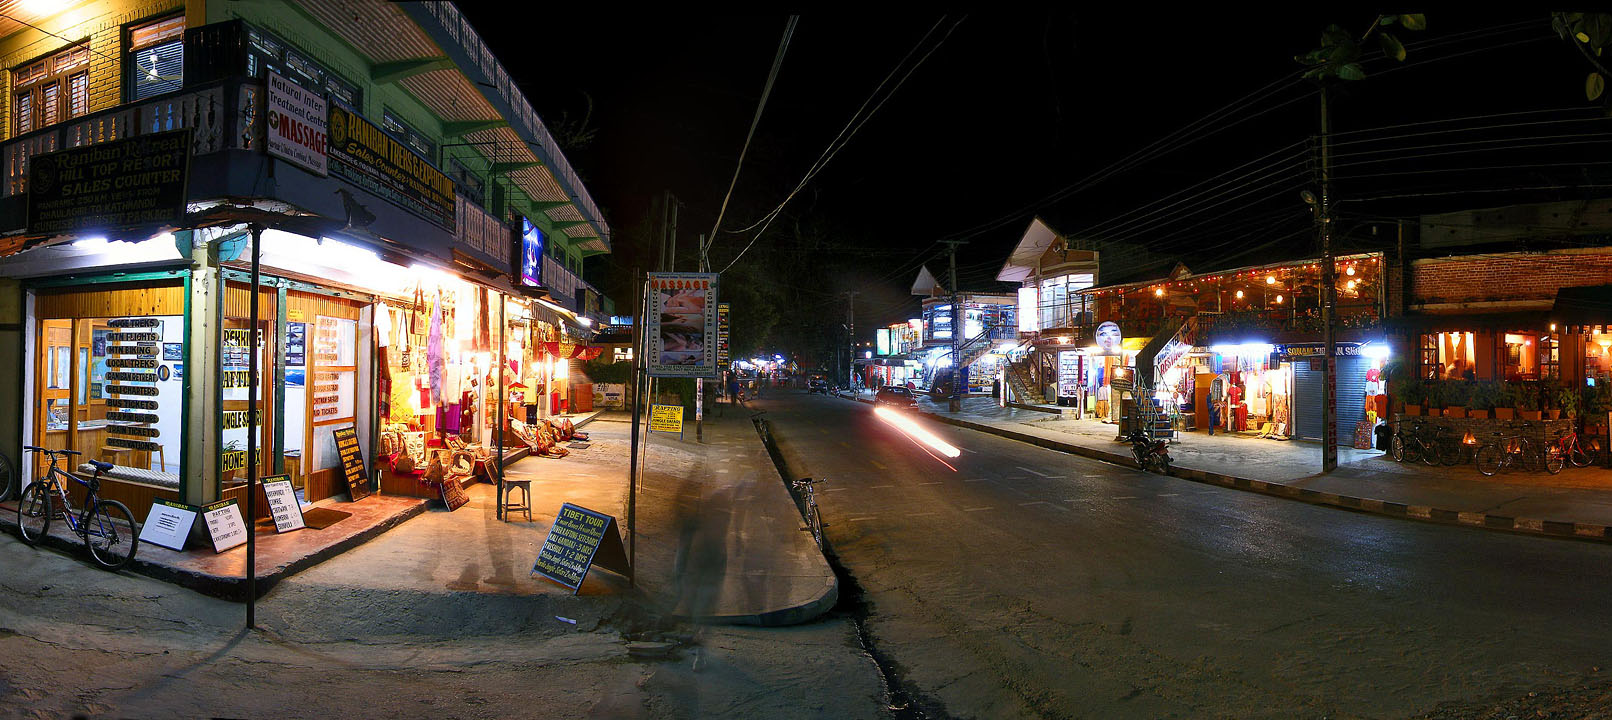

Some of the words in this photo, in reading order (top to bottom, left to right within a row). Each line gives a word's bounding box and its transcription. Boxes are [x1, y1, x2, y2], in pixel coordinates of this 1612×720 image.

[271, 76, 302, 102] Natural
[303, 94, 323, 112] Inter
[270, 91, 305, 118] Treatment
[306, 110, 327, 129] Centre
[279, 112, 327, 156] MASSAGE
[346, 142, 376, 165] Sales
[375, 157, 409, 184] Counter
[389, 138, 414, 177] TREKS
[60, 166, 83, 181] HILL
[90, 162, 118, 178] TOP
[62, 178, 112, 198] SALES
[115, 168, 181, 192] COUNTER
[651, 280, 709, 290] MASSAGE
[126, 333, 156, 341] FLIGHTS
[223, 329, 262, 348] REKKIG
[126, 346, 151, 354] BIKING
[107, 359, 129, 368] LOCAL
[131, 360, 155, 369] TREKS
[223, 370, 262, 389] AFTIG
[107, 399, 122, 408] BUS
[125, 401, 155, 410] TICKETS
[222, 450, 246, 471] HOME
[563, 508, 586, 521] TIBET
[586, 514, 605, 528] TOUR
